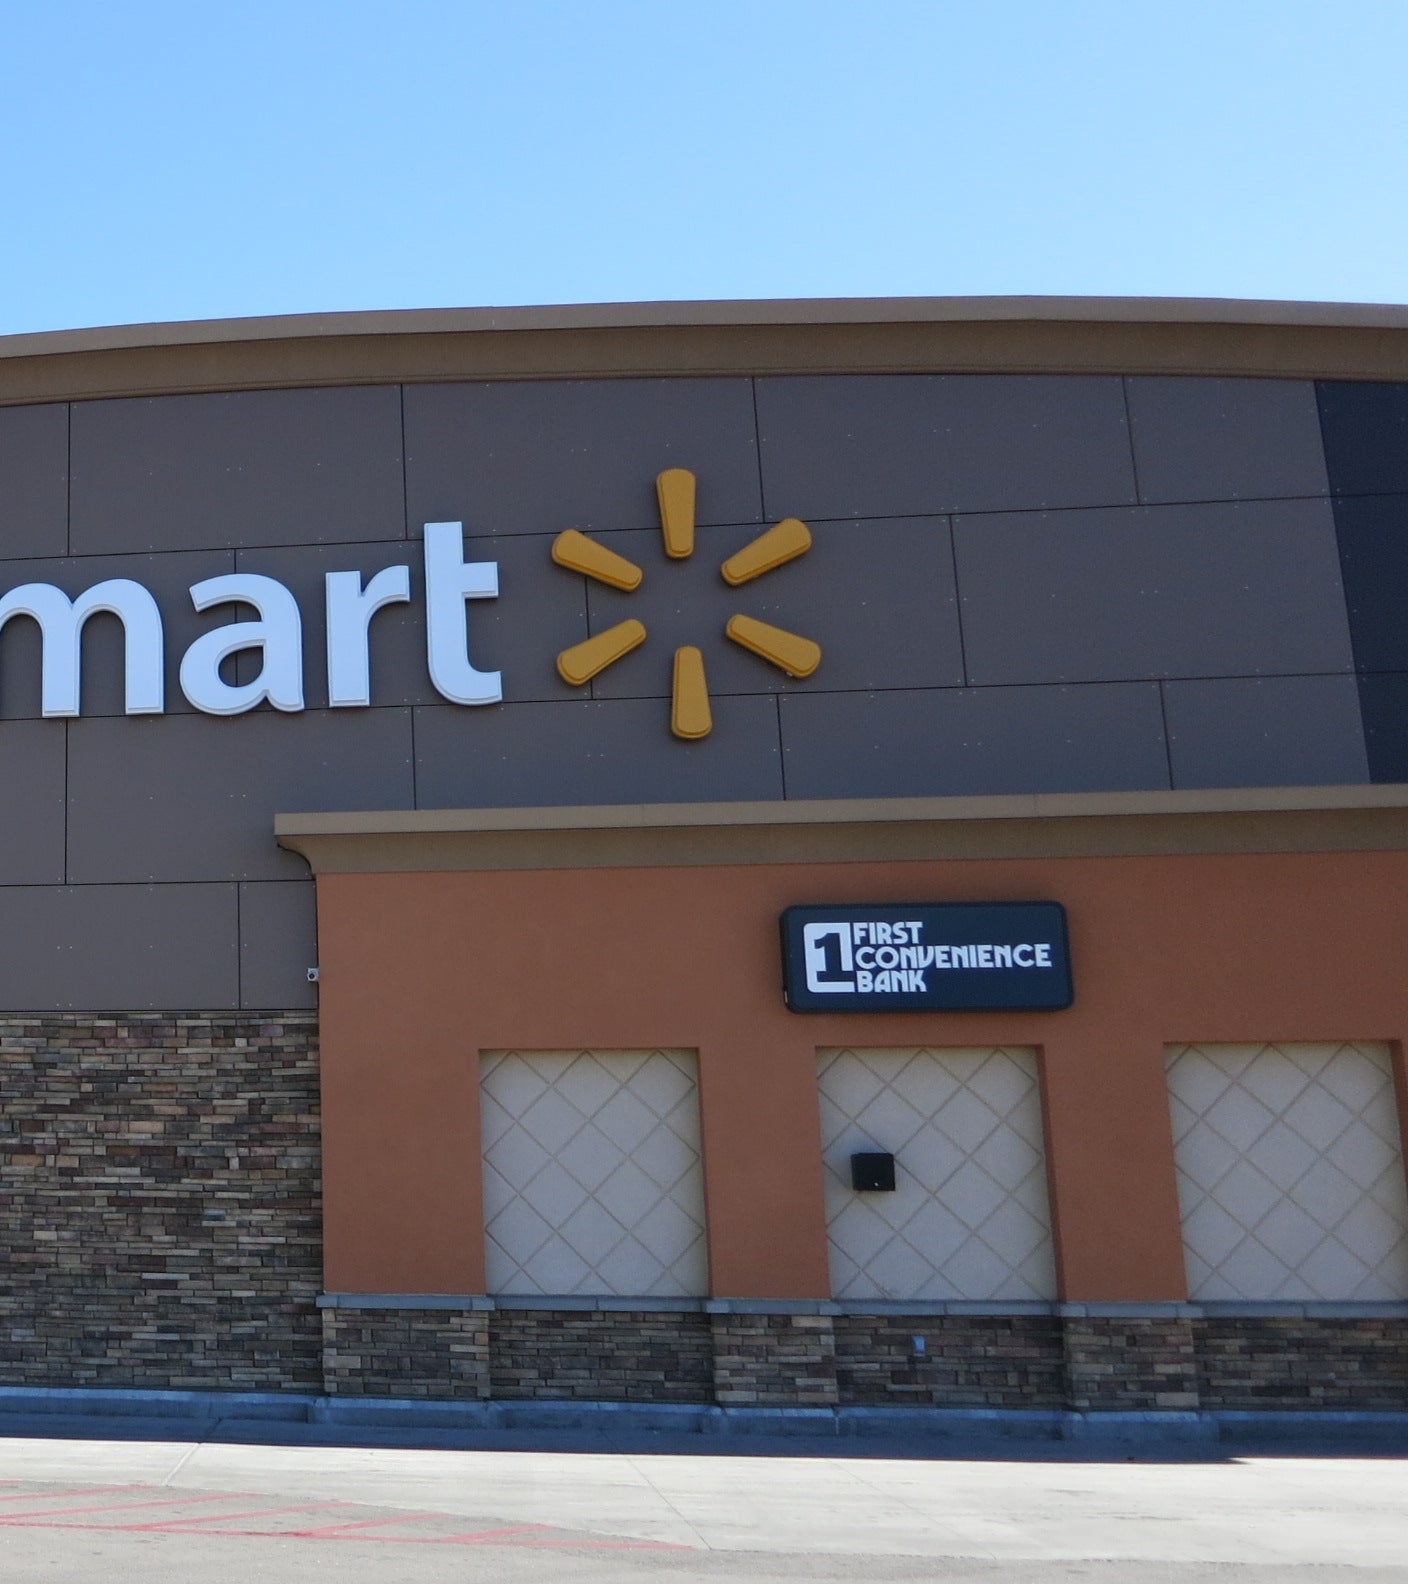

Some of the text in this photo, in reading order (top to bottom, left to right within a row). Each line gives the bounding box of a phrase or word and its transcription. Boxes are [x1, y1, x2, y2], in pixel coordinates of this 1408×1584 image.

[853, 921, 923, 944] FIRST
[855, 944, 1052, 969] CONVENIENCE
[856, 970, 927, 993] BANK
